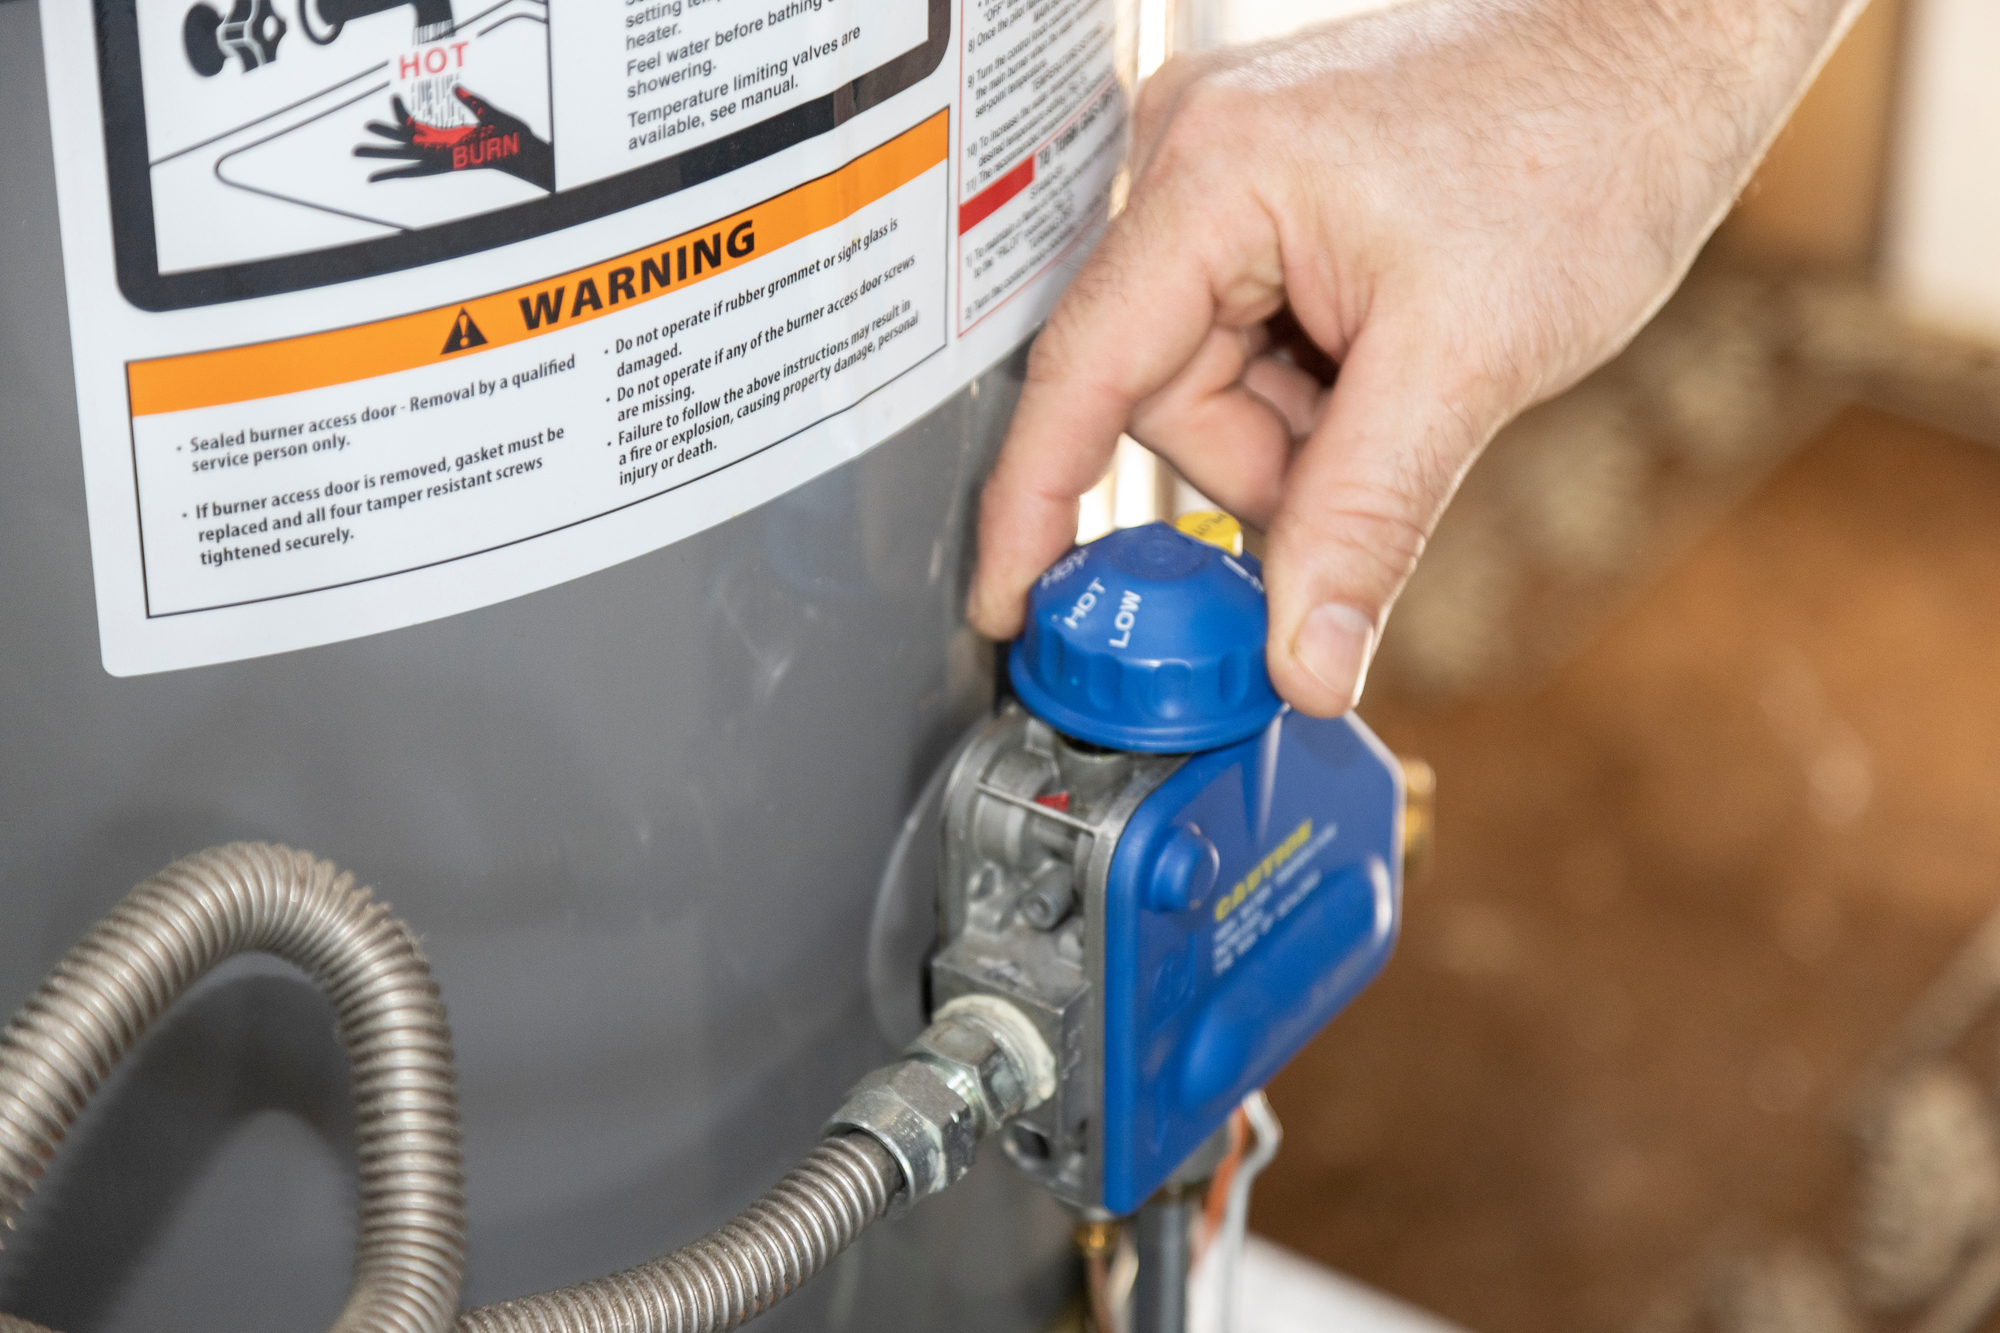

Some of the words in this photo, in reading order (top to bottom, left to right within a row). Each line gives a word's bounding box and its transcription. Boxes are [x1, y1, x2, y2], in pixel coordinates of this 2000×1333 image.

[625, 0, 682, 28] setting
[625, 23, 682, 51] heater.
[977, 27, 996, 46] Once
[399, 40, 469, 80] HOT
[627, 52, 662, 76] Feel
[666, 37, 710, 63] water
[715, 18, 763, 47] before
[768, 0, 822, 26] bathing
[627, 58, 717, 98] showering.
[628, 83, 729, 128] Temperature
[733, 59, 788, 92] limiting
[792, 38, 838, 67] valves
[841, 26, 861, 47] are
[976, 63, 993, 81] Turn
[988, 72, 1006, 91] main
[628, 114, 706, 151] available,
[710, 102, 737, 122] see
[741, 75, 799, 110] manual.
[452, 132, 520, 170] BURN
[979, 167, 991, 183] The
[518, 220, 755, 331] WARNING
[615, 338, 633, 354] Do
[636, 327, 659, 347] not
[661, 310, 711, 339] operate
[713, 302, 724, 317] if
[725, 286, 765, 313] rubber
[768, 259, 821, 297] grommet
[823, 255, 836, 269] or
[838, 238, 862, 263] sight
[864, 225, 888, 250] glass
[890, 217, 898, 232] is
[617, 386, 634, 402] Do
[637, 375, 660, 395] not
[663, 357, 712, 385] operate
[714, 348, 724, 365] if
[726, 341, 747, 360] any
[750, 332, 763, 349] of
[764, 325, 784, 343] the
[786, 306, 825, 333] burner
[827, 289, 859, 315] access
[860, 273, 882, 296] door
[884, 254, 916, 282] screws
[617, 342, 682, 377] damaged.
[618, 420, 663, 446] Failure
[666, 414, 679, 427] to
[682, 397, 720, 422] follow
[724, 388, 743, 405] the
[747, 370, 781, 395] above
[783, 336, 849, 378] instructions
[851, 324, 869, 345] may
[872, 304, 900, 331] result
[902, 299, 911, 313] in
[190, 430, 245, 453] Sealed
[250, 421, 305, 443] burner
[308, 413, 356, 433] access
[361, 404, 397, 422] door
[409, 382, 475, 412] Removal
[479, 379, 496, 396] by
[500, 377, 508, 389] a
[512, 354, 575, 389] qualified
[617, 405, 639, 422] are
[642, 385, 695, 413] missing.
[619, 453, 627, 465] a
[630, 444, 652, 462] fire
[655, 438, 669, 452] or
[671, 412, 734, 446] explosion,
[737, 390, 780, 419] causing
[783, 366, 831, 400] property
[834, 341, 877, 373] damage,
[878, 310, 919, 350] personal
[192, 452, 249, 472] service
[253, 443, 308, 466] person
[312, 432, 351, 452] only.
[196, 503, 209, 519] If
[212, 496, 267, 517] burner
[271, 487, 320, 507] access
[324, 479, 360, 497] door
[364, 474, 376, 489] is
[380, 456, 452, 487] removed,
[455, 443, 504, 471] gasket
[507, 431, 544, 454] must
[547, 427, 565, 442] be
[619, 462, 658, 485] injury
[661, 456, 674, 470] or
[677, 438, 717, 463] death.
[198, 517, 268, 543] replaced
[272, 510, 302, 531] and
[306, 507, 326, 524] all
[330, 502, 362, 520] four
[366, 488, 423, 512] tamper
[426, 469, 492, 499] resistant
[495, 456, 543, 481] screws
[200, 539, 281, 567] tightened
[285, 527, 355, 551] securely.
[1064, 577, 1106, 630] HOT
[1109, 590, 1142, 649] LOW
